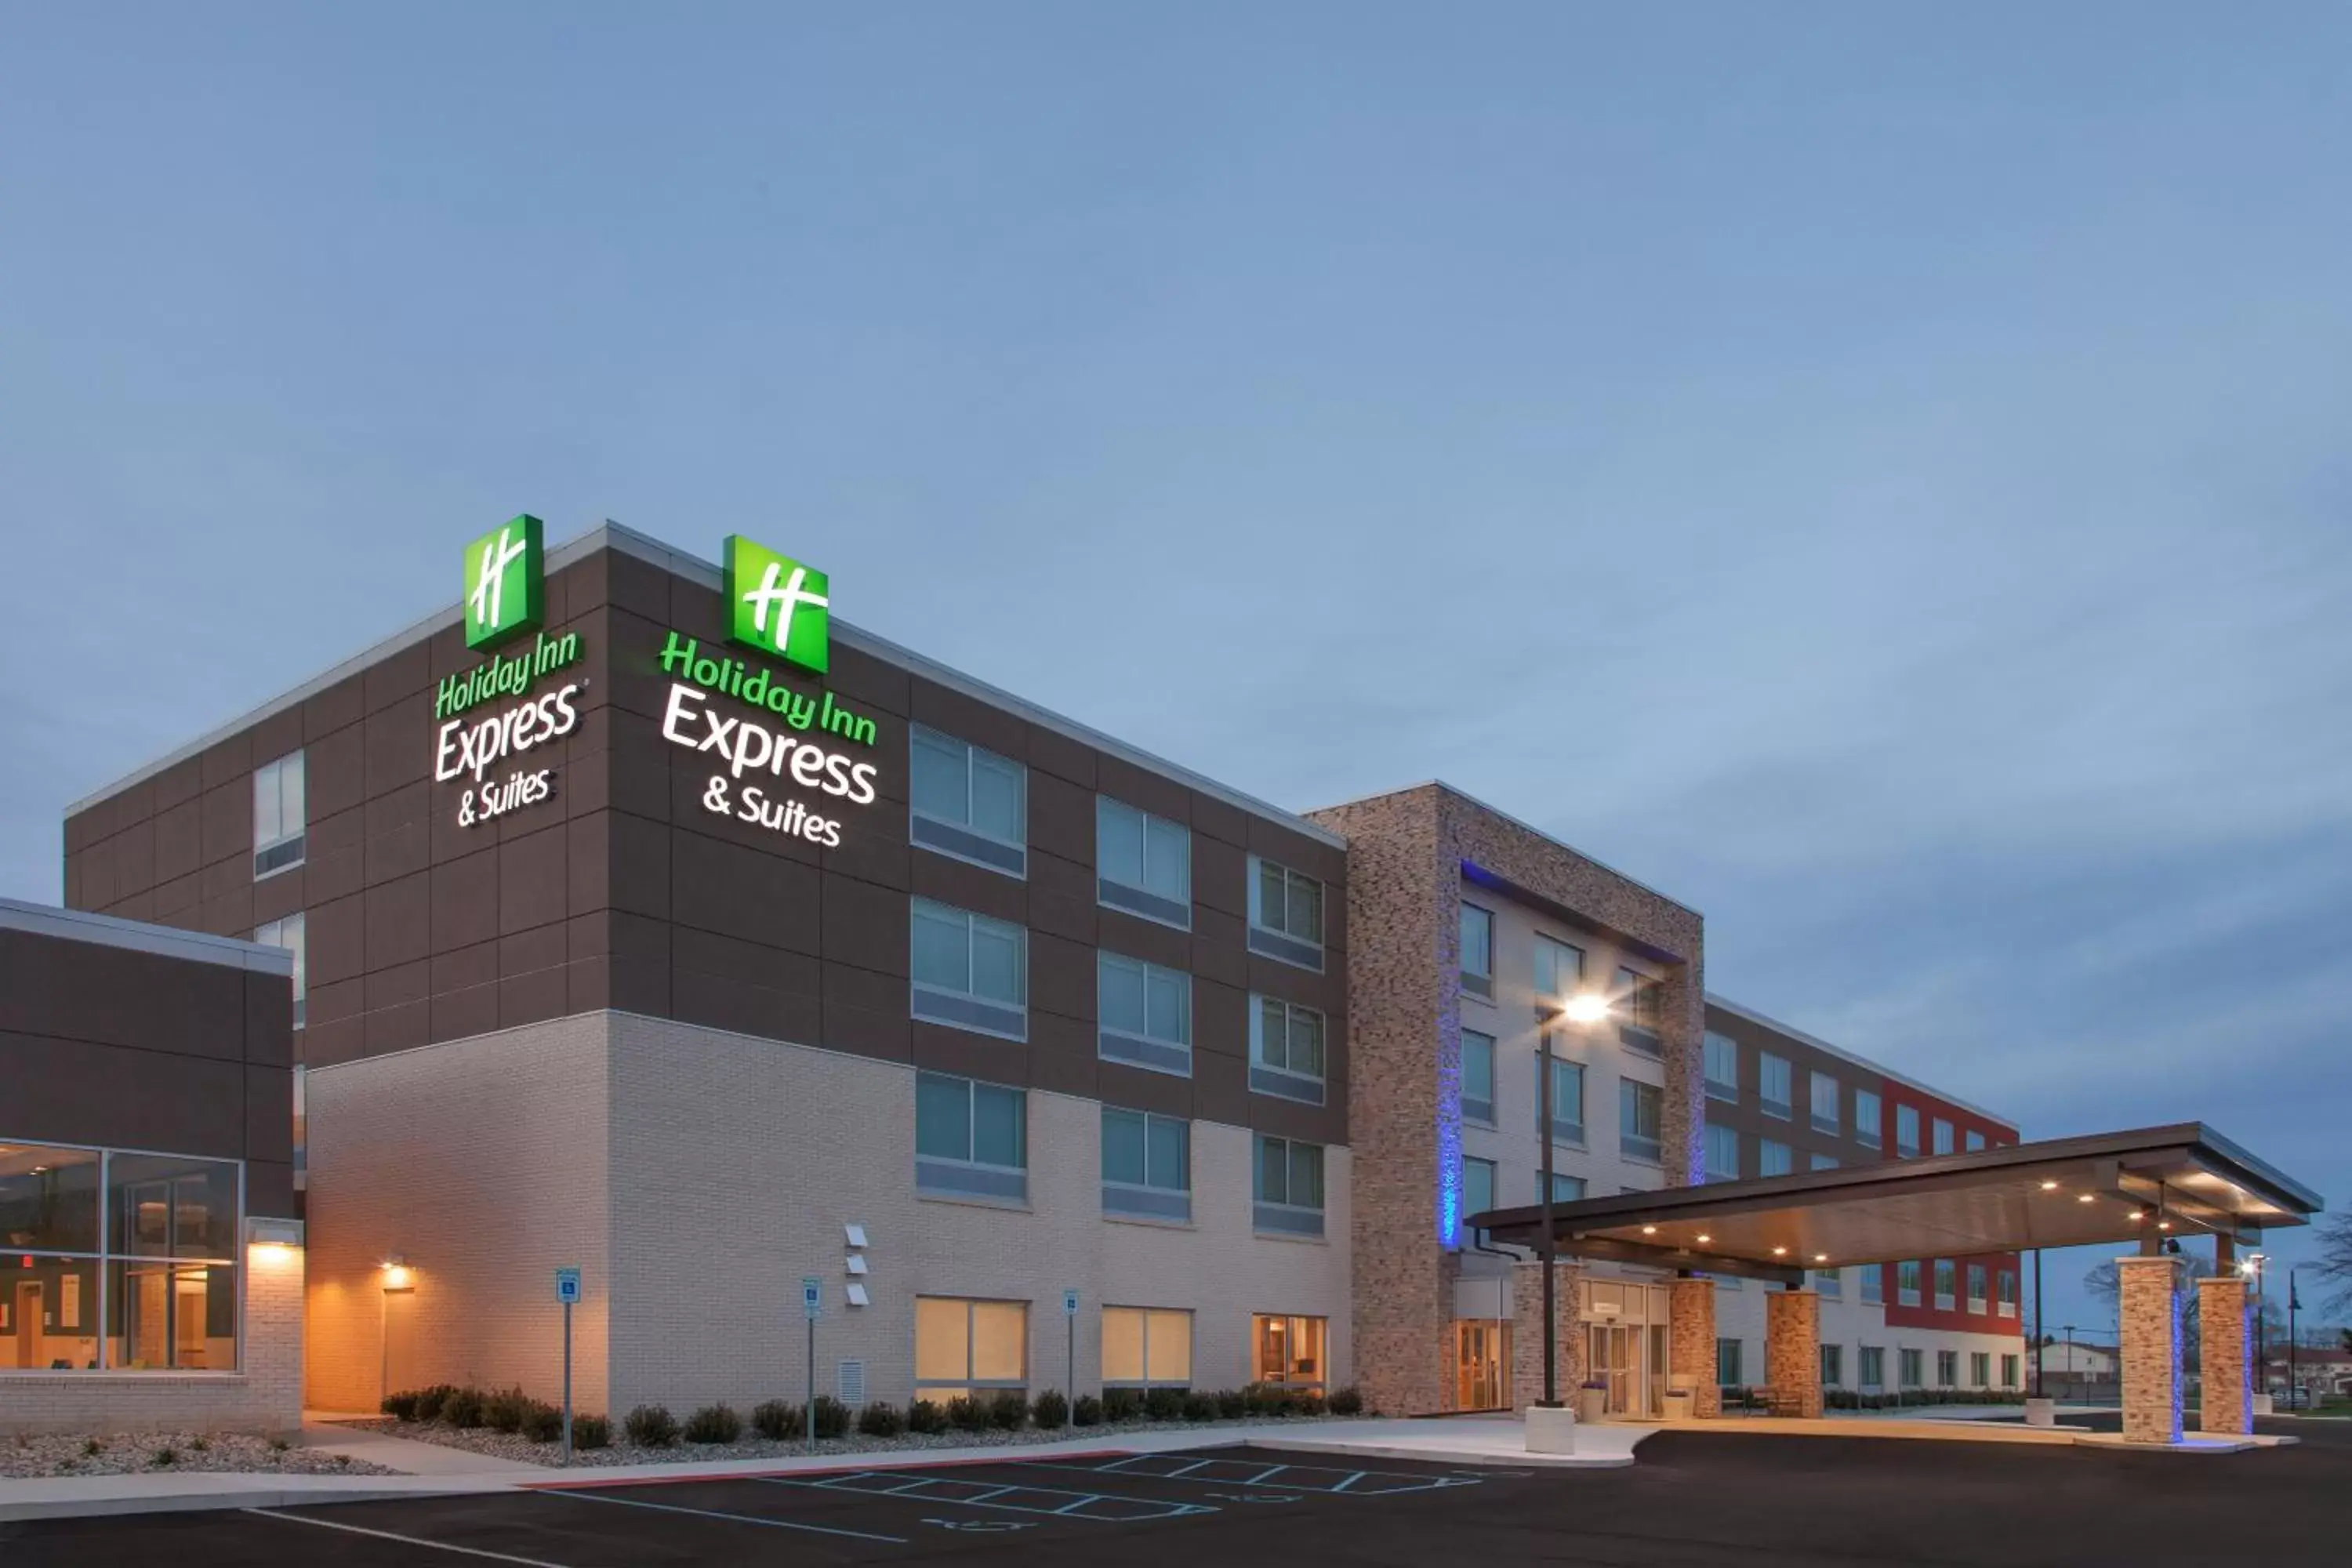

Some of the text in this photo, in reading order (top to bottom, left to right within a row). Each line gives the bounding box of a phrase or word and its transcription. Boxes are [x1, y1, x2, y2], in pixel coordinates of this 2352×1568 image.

[435, 632, 576, 720] Holiday Inn
[659, 630, 877, 746] Holiday Inn
[435, 684, 578, 782] Express
[662, 682, 878, 804] Express
[458, 768, 550, 828] & Suites
[702, 775, 842, 848] & Suites
